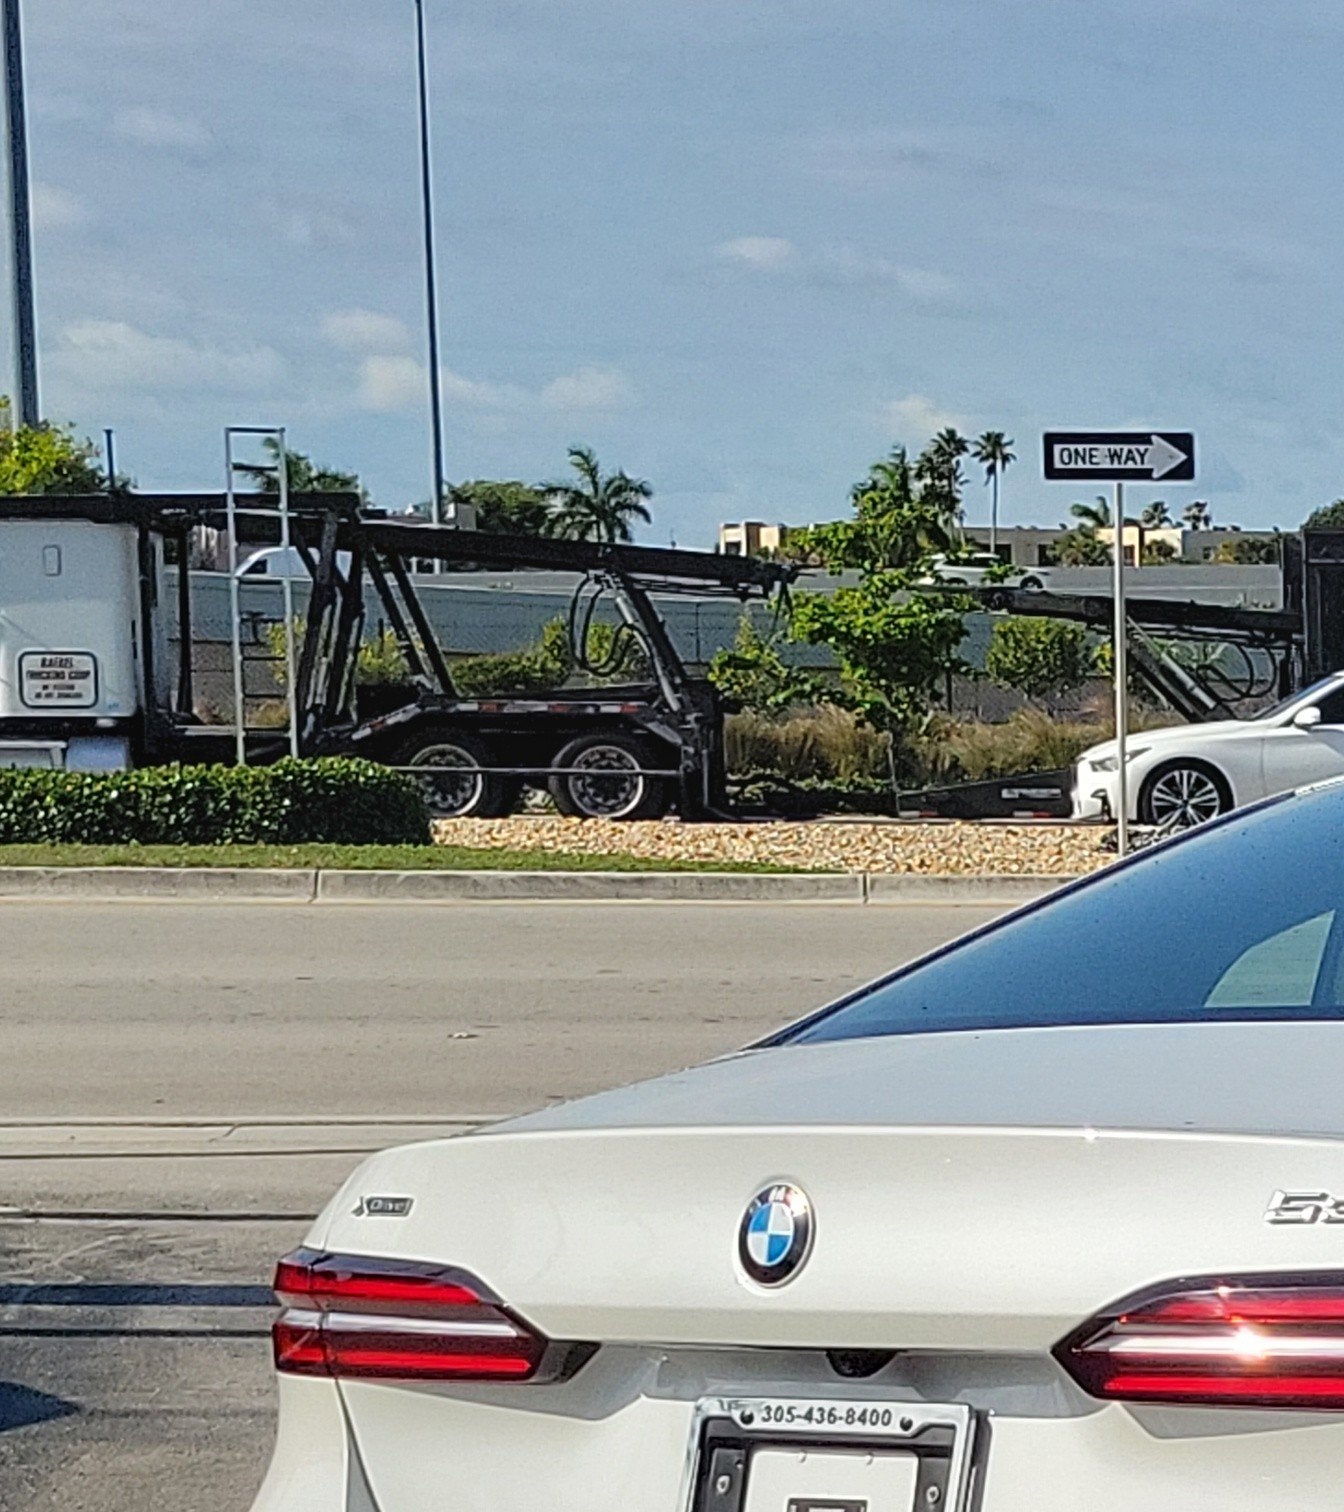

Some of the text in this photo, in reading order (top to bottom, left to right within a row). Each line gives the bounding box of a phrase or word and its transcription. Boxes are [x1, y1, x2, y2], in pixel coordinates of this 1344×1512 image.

[1059, 447, 1149, 466] ONE WAY
[761, 1404, 893, 1427] 305-436-8400
